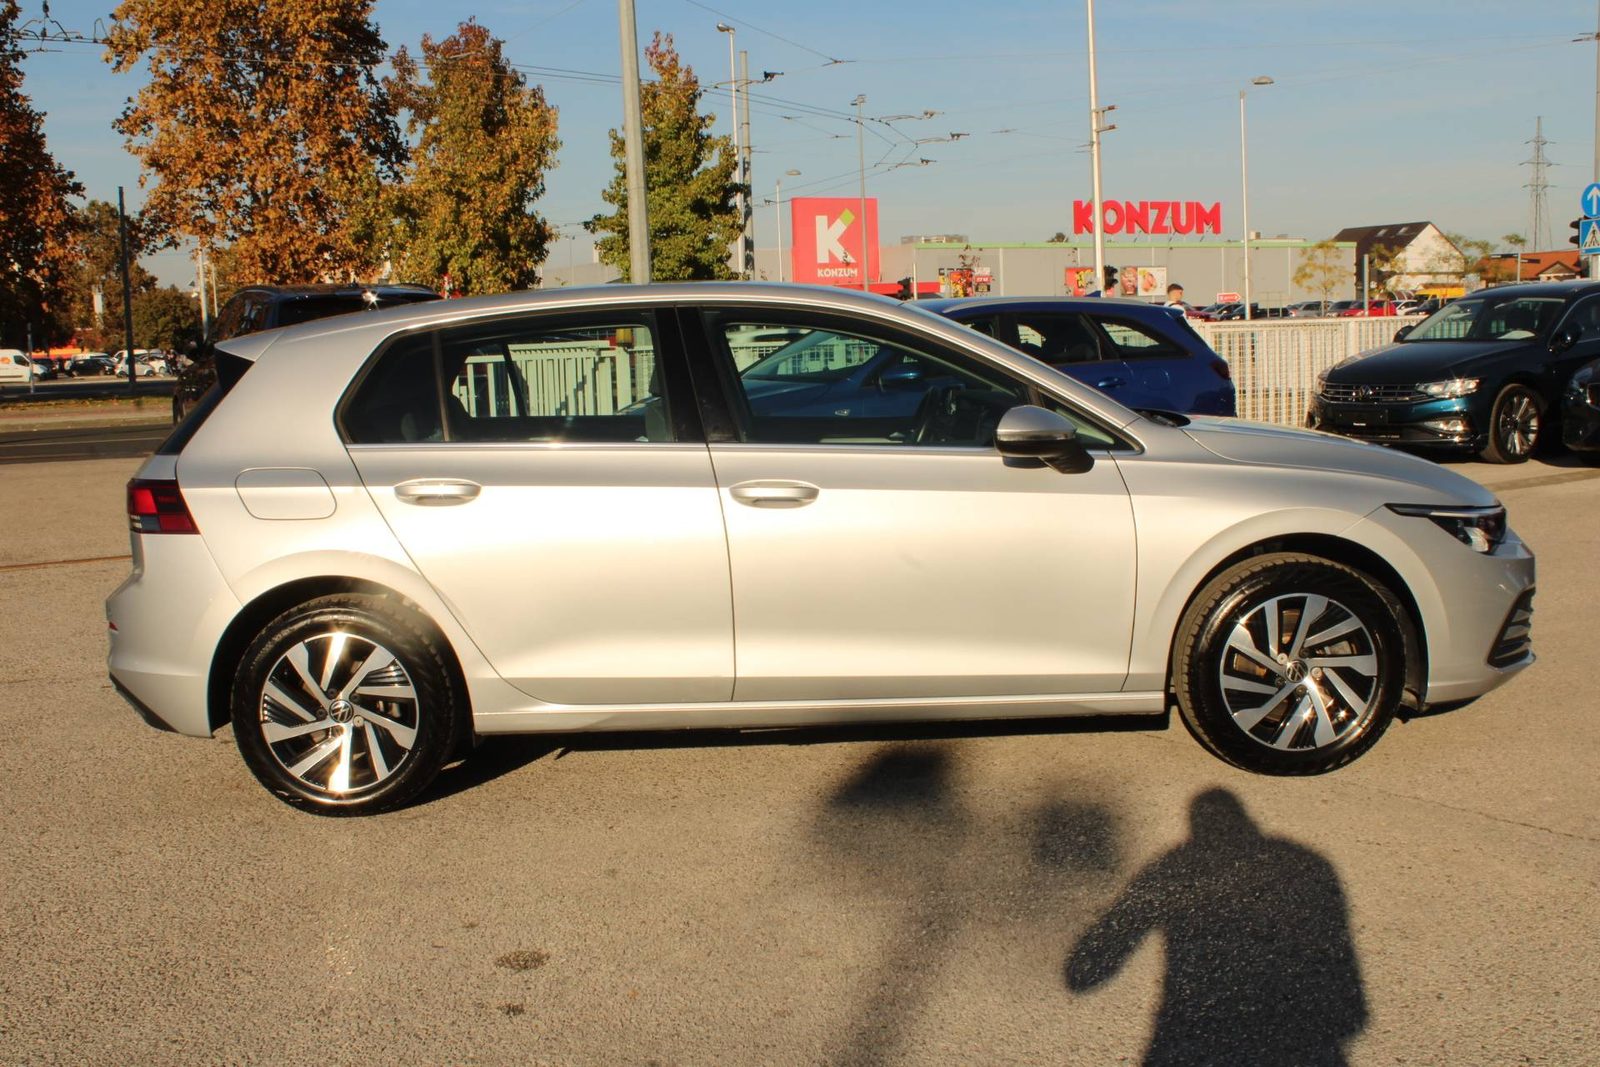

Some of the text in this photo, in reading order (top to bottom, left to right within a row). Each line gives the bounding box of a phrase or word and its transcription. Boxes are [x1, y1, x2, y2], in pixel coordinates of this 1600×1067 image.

[1073, 200, 1221, 235] KONZUM
[815, 207, 857, 264] K
[817, 267, 858, 277] KONZUM
